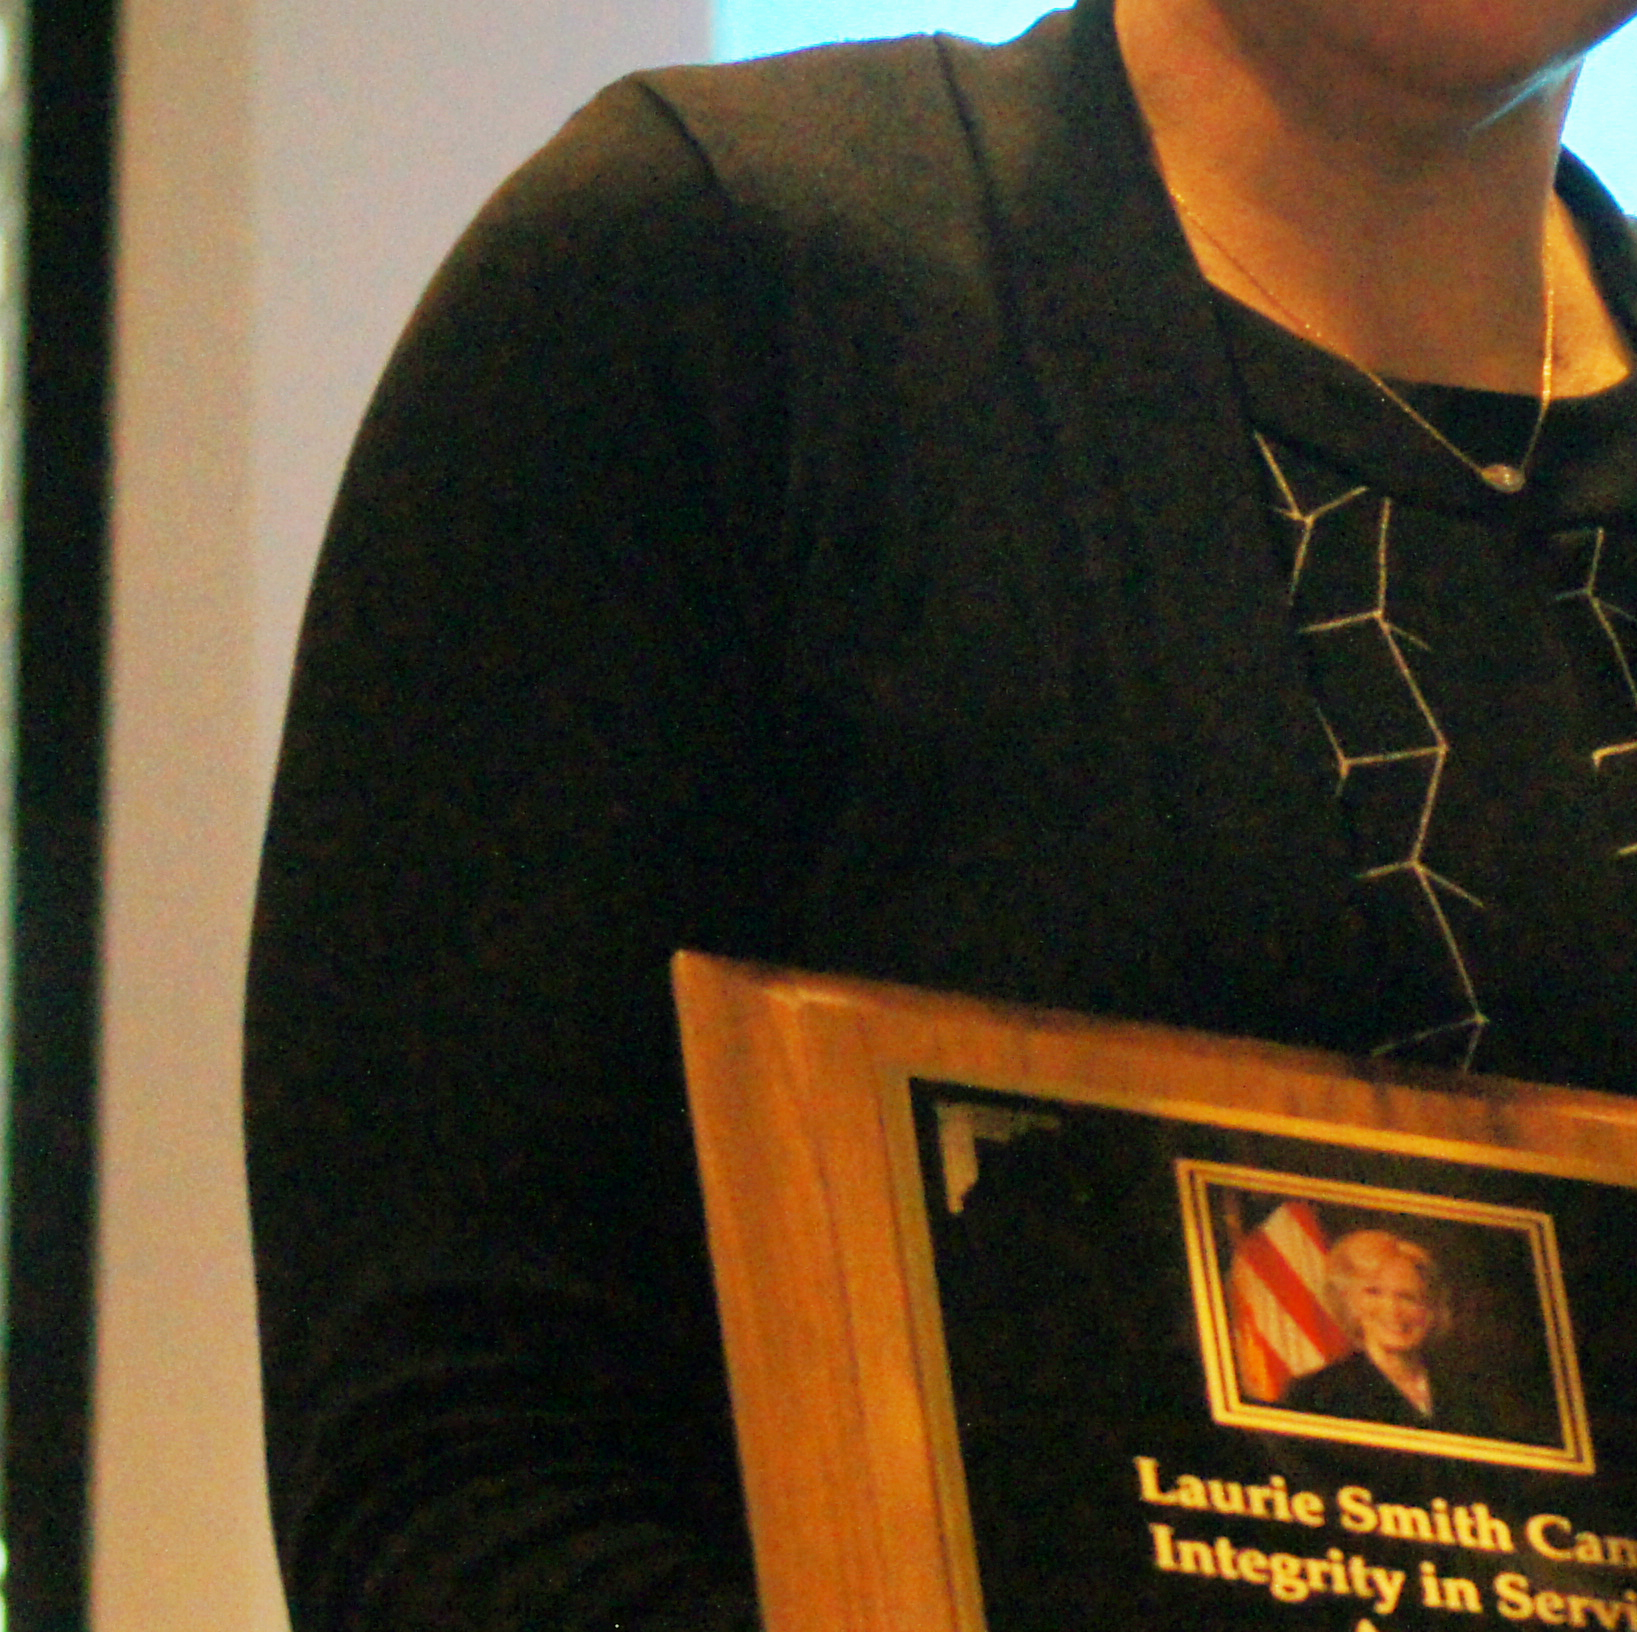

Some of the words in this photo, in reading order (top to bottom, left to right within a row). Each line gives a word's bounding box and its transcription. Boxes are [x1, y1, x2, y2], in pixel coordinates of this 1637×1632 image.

[1134, 1455, 1325, 1528] Laurie
[1337, 1484, 1515, 1553] Smith
[1149, 1522, 1406, 1615] Integrity
[1420, 1560, 1482, 1614] in
